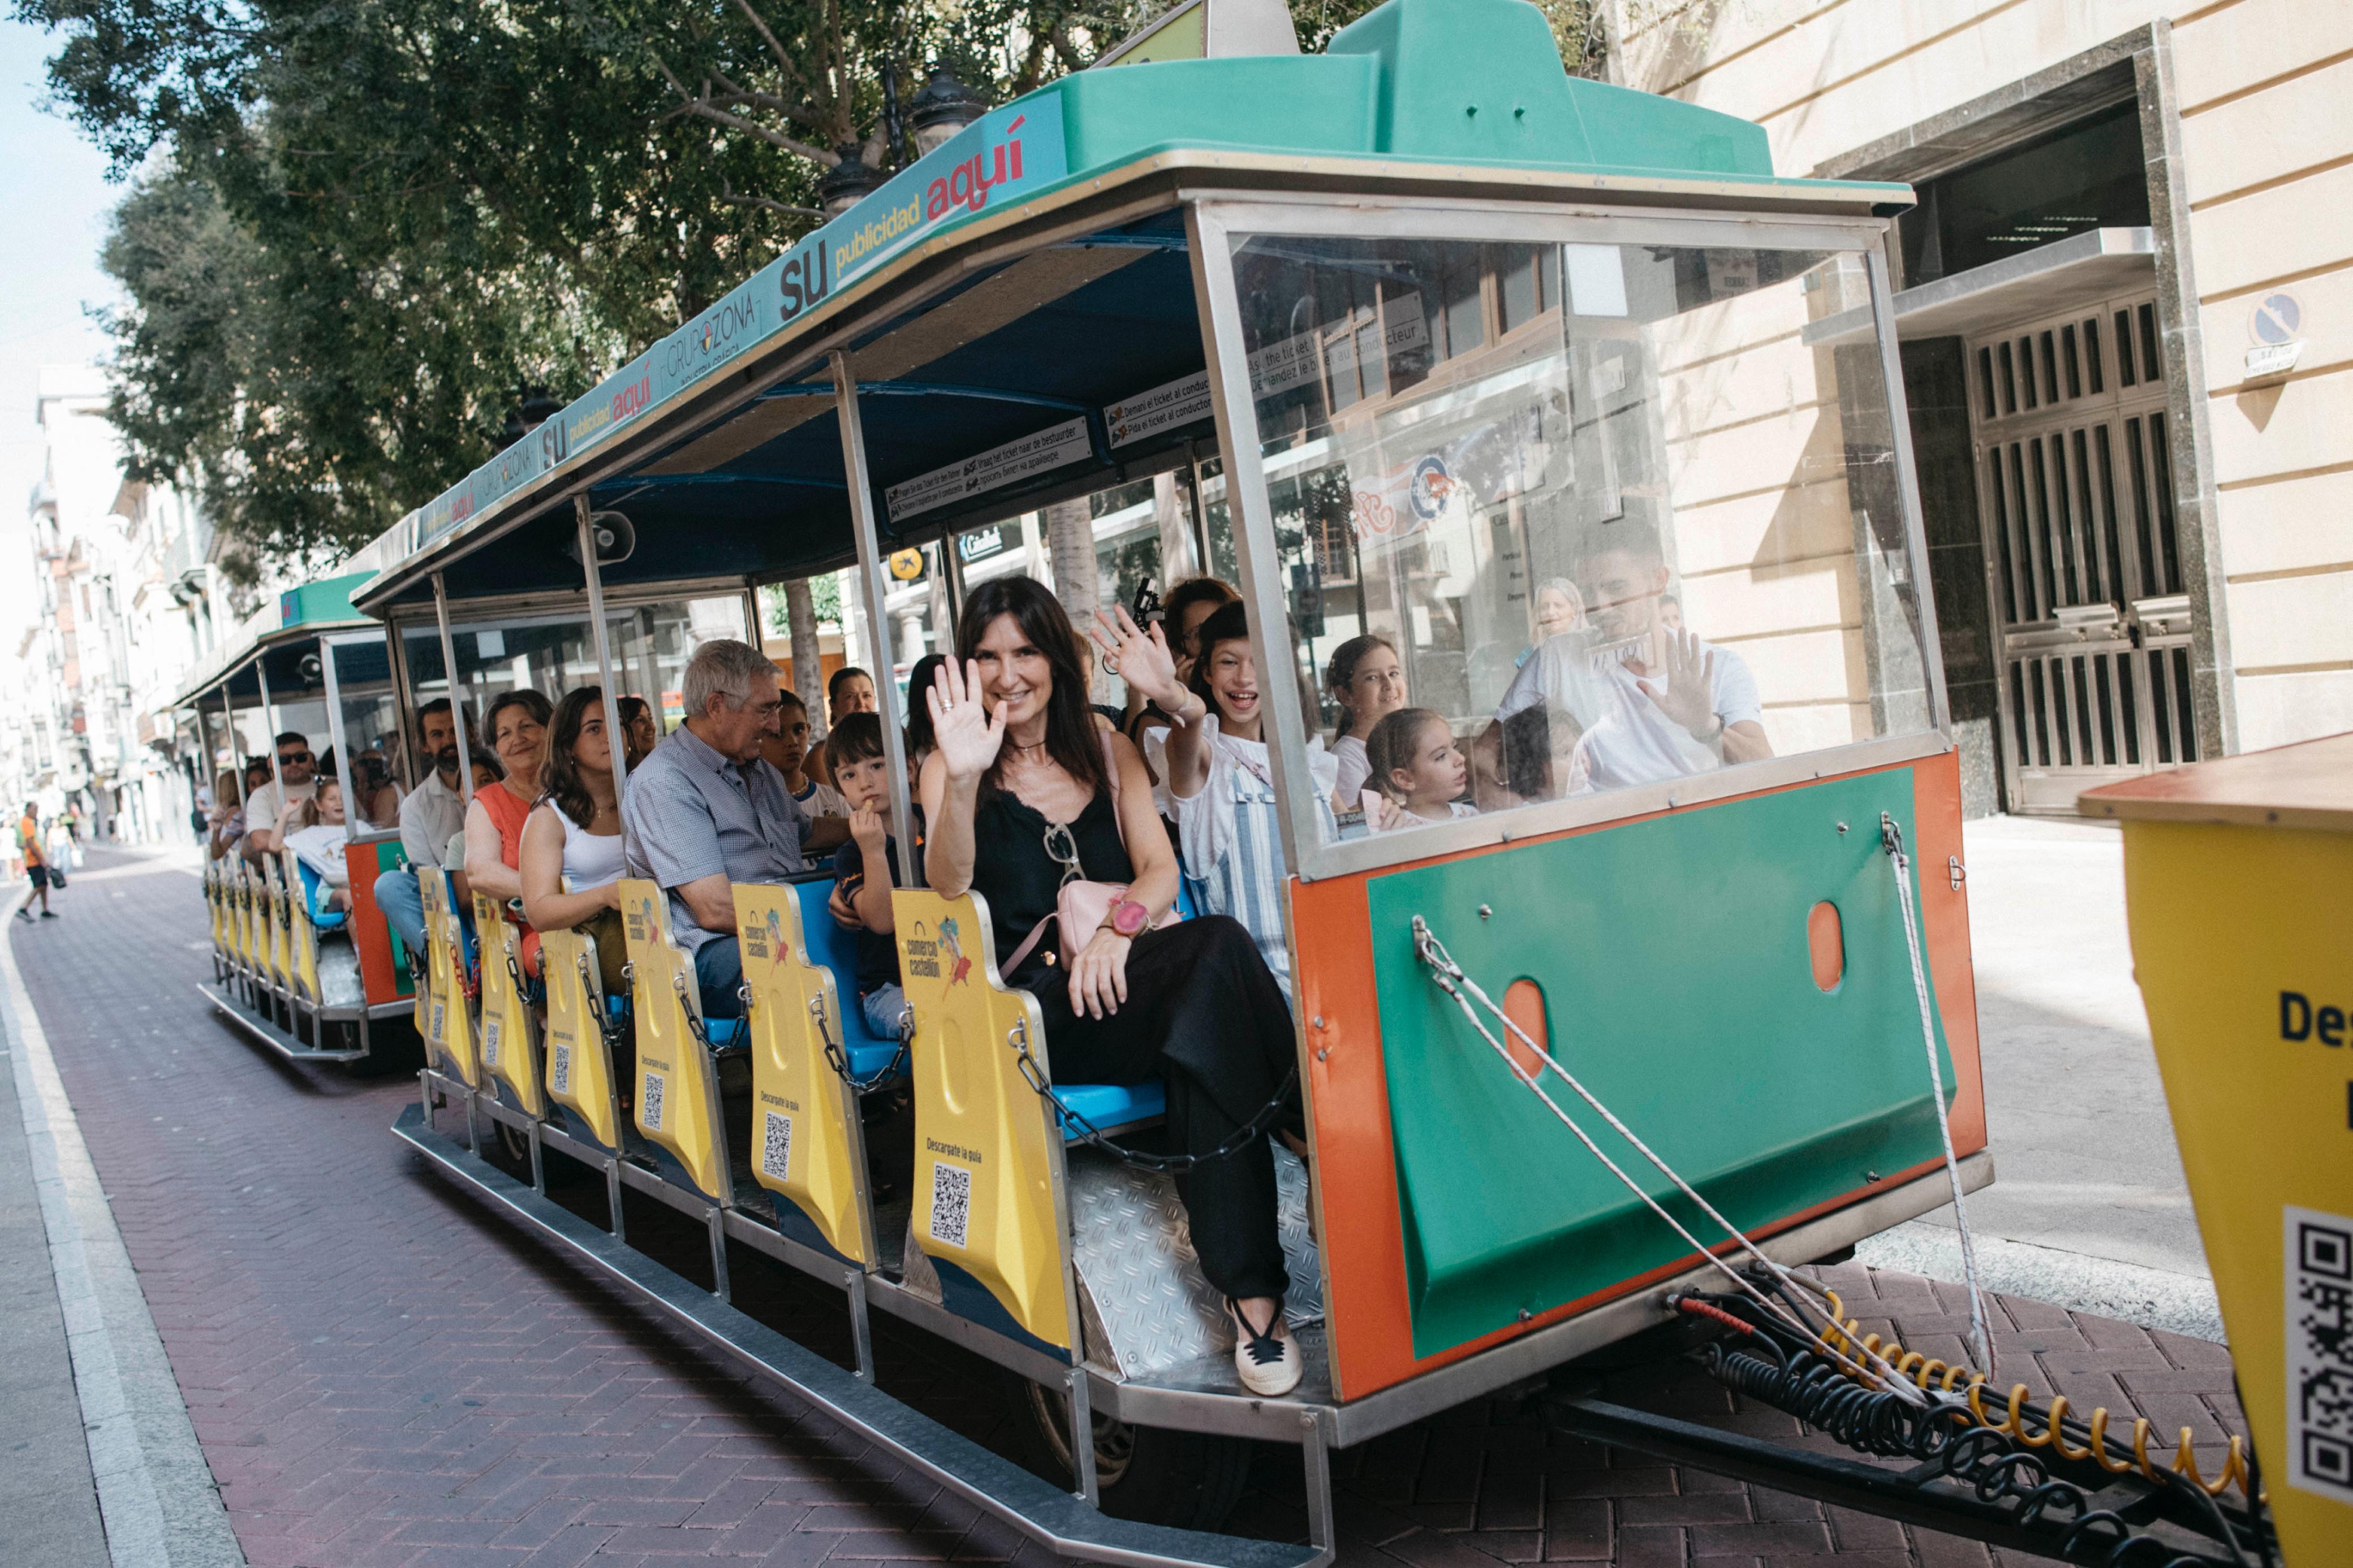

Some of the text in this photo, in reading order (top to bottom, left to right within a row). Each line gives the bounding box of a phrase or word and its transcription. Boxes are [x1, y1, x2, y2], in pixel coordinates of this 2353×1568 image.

[835, 193, 920, 278] publicidad
[926, 115, 1026, 221] aquí
[1265, 351, 1281, 366] the
[1299, 362, 1308, 375] le
[1354, 325, 1416, 356] condcteur
[613, 358, 650, 421] aquí
[1153, 391, 1173, 407] ticket
[1174, 387, 1181, 399] al
[1148, 412, 1167, 428] ticket
[1168, 409, 1174, 421] al
[1175, 398, 1211, 418] conductor
[1019, 443, 1032, 455] naar
[1033, 438, 1041, 448] de
[1041, 427, 1076, 445] bestuurder
[907, 939, 938, 957] comercio
[910, 958, 941, 978] castellón
[2278, 991, 2353, 1048] De
[926, 1137, 982, 1163] Descargate la guía
